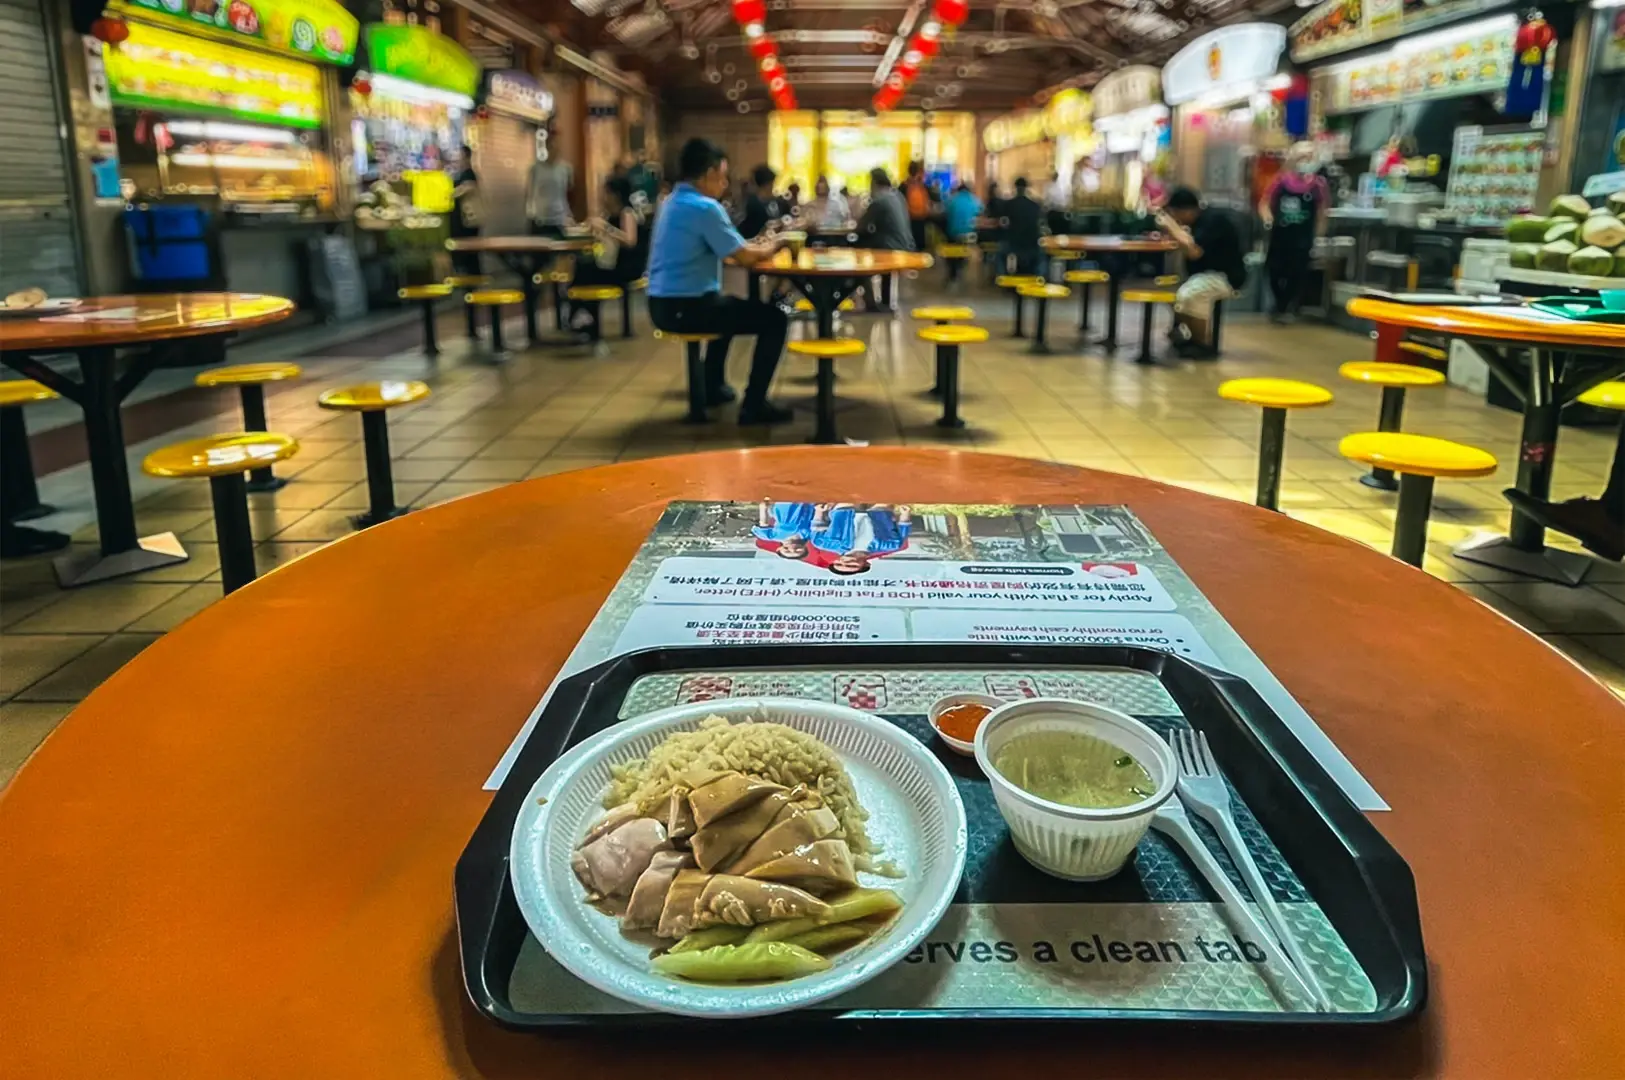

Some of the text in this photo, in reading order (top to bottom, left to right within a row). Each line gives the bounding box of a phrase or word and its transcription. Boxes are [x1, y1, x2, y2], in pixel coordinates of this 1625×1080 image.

[740, 588, 781, 597] (HFE)
[784, 589, 852, 598] Eligibility
[856, 590, 884, 598] Flat
[1041, 594, 1066, 602] flat
[1084, 594, 1106, 602] for
[1108, 594, 1152, 602] Apply
[1072, 626, 1125, 634] monthly
[1000, 634, 1030, 642] with
[1058, 636, 1123, 644] $300,000
[1135, 636, 1170, 644] Own
[902, 934, 1268, 964] erves a clean tab
